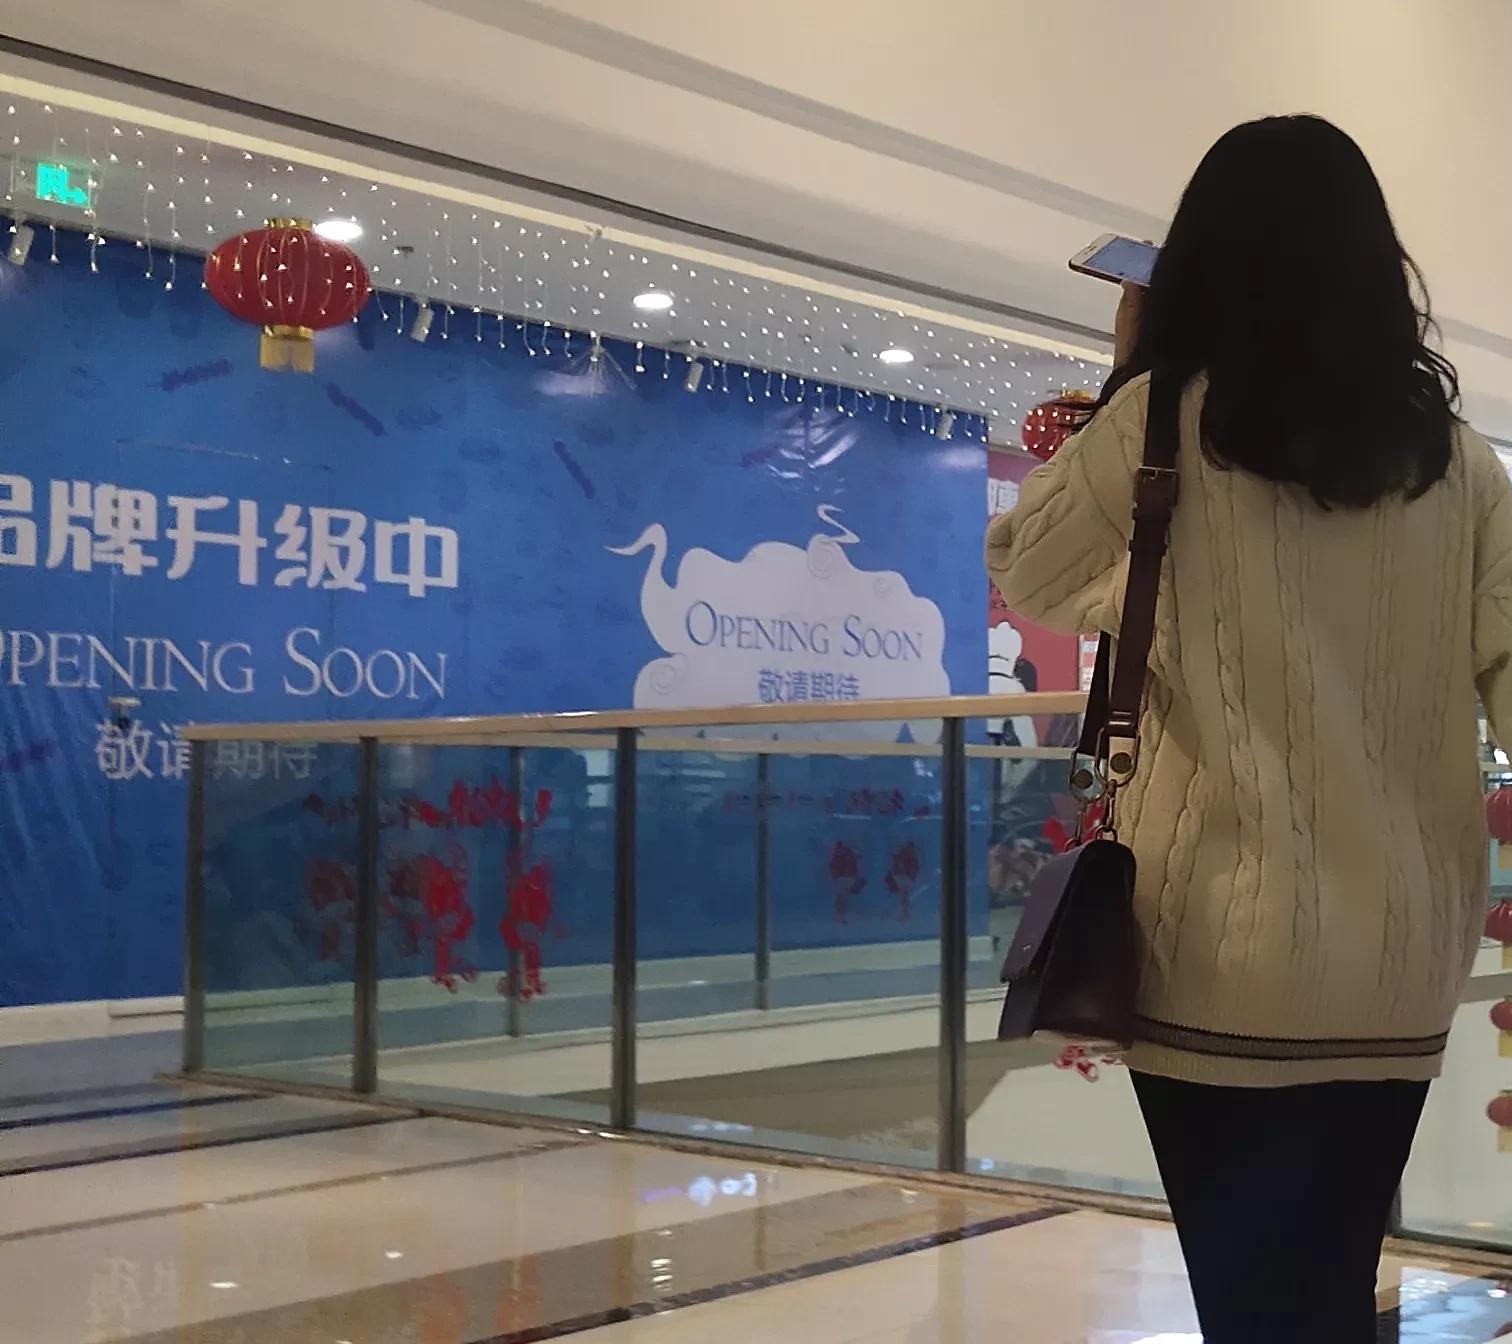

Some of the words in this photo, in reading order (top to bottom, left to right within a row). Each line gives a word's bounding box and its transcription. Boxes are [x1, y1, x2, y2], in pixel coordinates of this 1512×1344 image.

[686, 600, 830, 655] OPENING
[842, 614, 923, 662] SOON
[0, 628, 255, 694] PENING
[284, 627, 449, 700] SOON
[758, 668, 861, 704] 敬请期待
